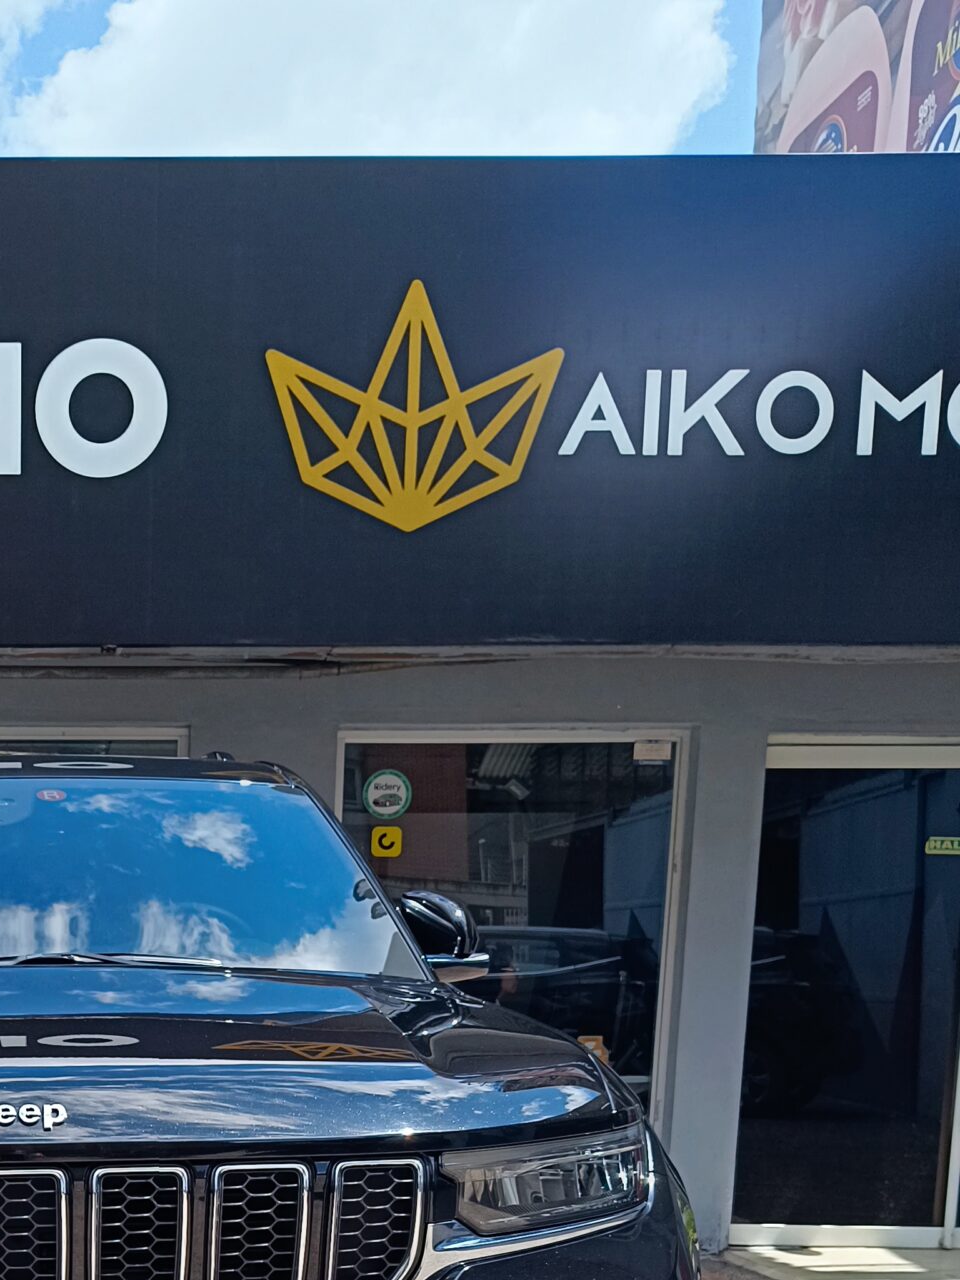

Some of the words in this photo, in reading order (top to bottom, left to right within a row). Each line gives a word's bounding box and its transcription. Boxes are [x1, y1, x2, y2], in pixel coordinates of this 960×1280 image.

[558, 368, 835, 457] AIKO
[856, 369, 960, 457] M
[373, 782, 402, 793] Ridery
